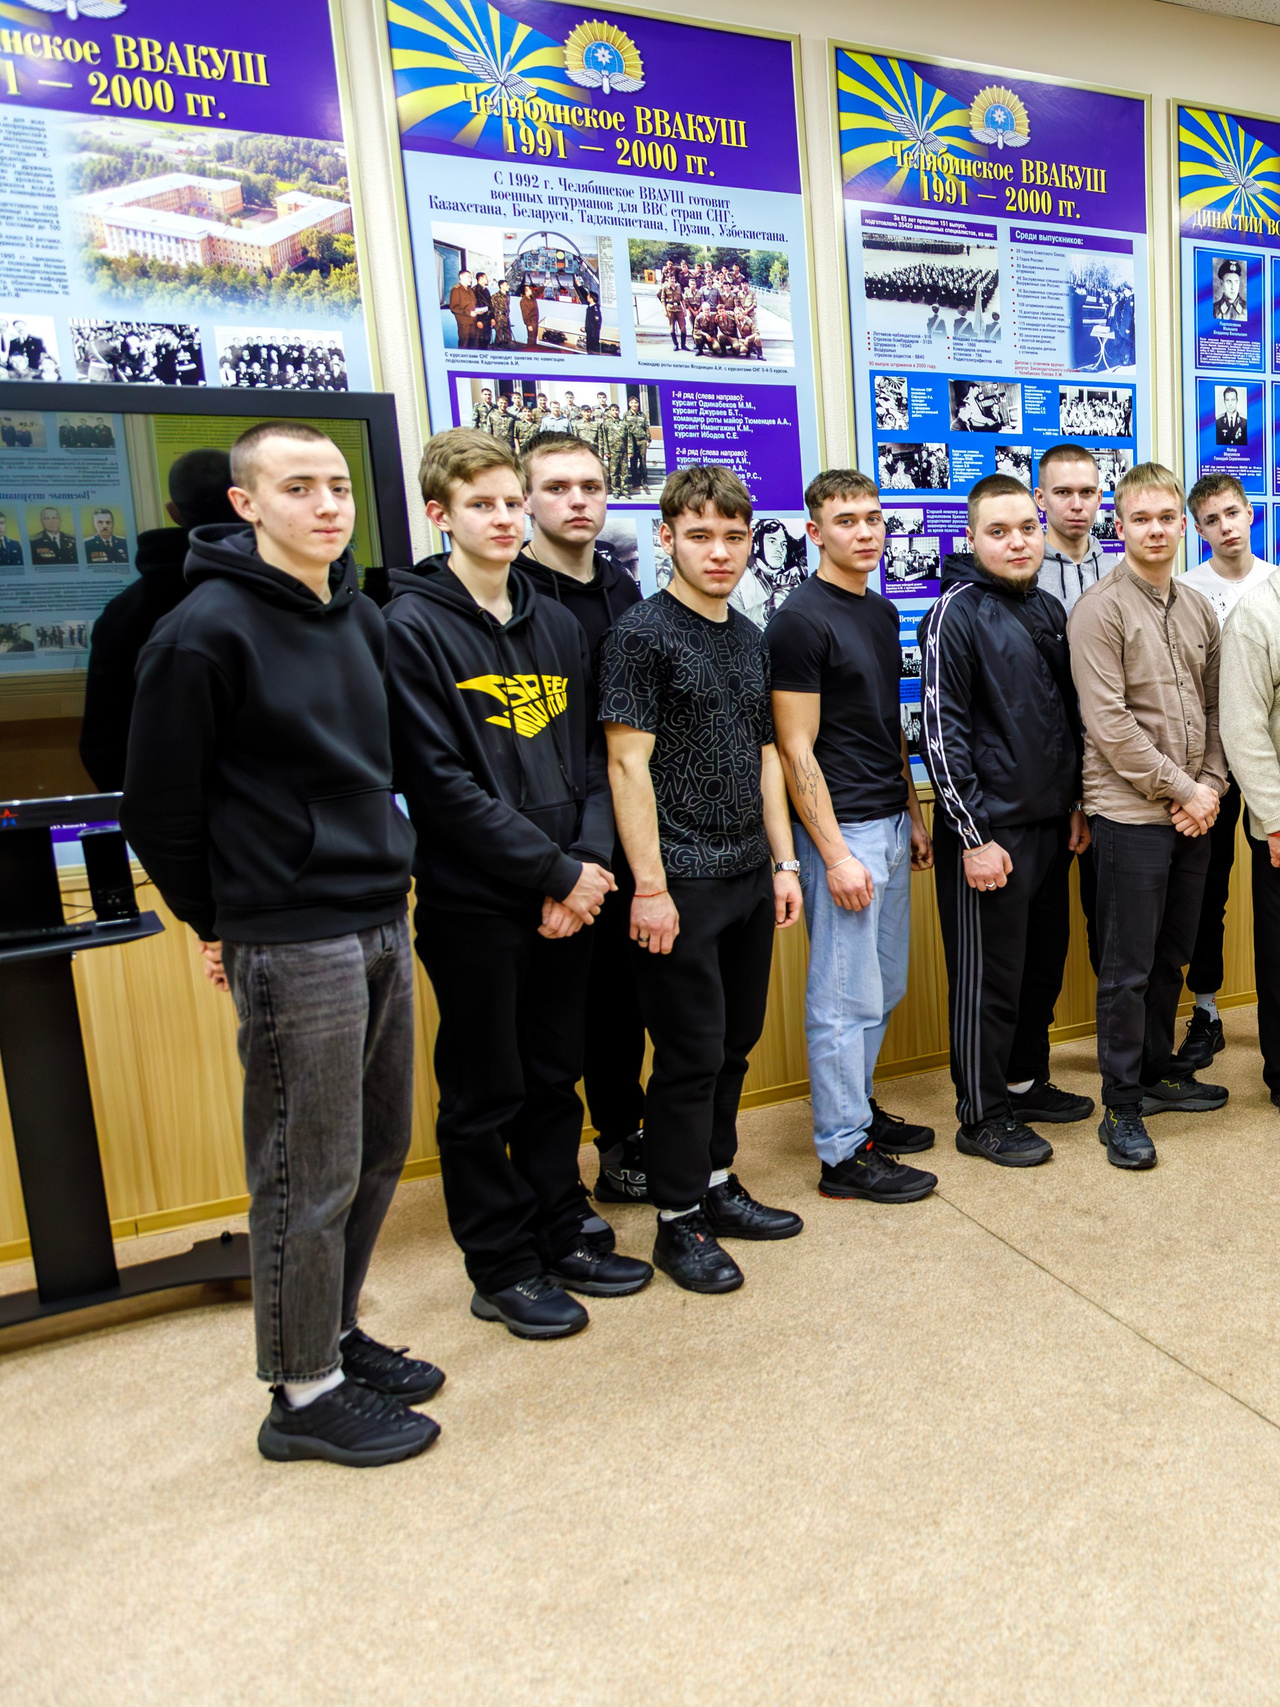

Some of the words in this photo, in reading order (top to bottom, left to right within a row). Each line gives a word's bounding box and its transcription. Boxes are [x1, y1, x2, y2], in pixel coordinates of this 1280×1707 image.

[112, 34, 270, 86] ВВАКУШ
[88, 72, 174, 113] 2000
[185, 92, 226, 120] гг.
[457, 82, 626, 131] Челябинское
[634, 105, 748, 148] ВВАКУШ
[504, 123, 567, 159] 1991
[615, 137, 677, 172] 2000
[685, 154, 716, 177] гг.
[887, 140, 1013, 181] Челябинское
[1020, 158, 1107, 193] ВВАКУШ
[490, 189, 543, 204] военных
[547, 195, 613, 211] штурманов
[617, 202, 638, 213] для
[642, 201, 668, 217] ВВС
[671, 207, 703, 222] стран
[706, 209, 735, 224] СНГ:
[494, 170, 503, 185] С
[508, 171, 540, 189] 1992
[544, 179, 554, 190] г.
[558, 177, 635, 198] Челябинское
[639, 186, 684, 204] ВВАУШ
[688, 194, 731, 209] готовит
[921, 175, 968, 206] 1991
[1005, 186, 1052, 215] 2000
[1058, 199, 1081, 219] гг.
[428, 195, 507, 218] Казахстана,
[512, 203, 573, 224] Беларуси,
[577, 209, 668, 233] Таджикистана,
[672, 219, 715, 238] Грузии,
[719, 224, 789, 243] Узбекистана.
[1015, 230, 1037, 240] Среди
[1038, 234, 1084, 245] выпускников:
[1192, 209, 1264, 234] ДИНАСТИИ
[672, 407, 698, 415] курсант
[683, 392, 694, 400] ряд
[675, 431, 700, 439] курсант
[687, 449, 698, 457] ряд
[676, 456, 701, 464] курсант
